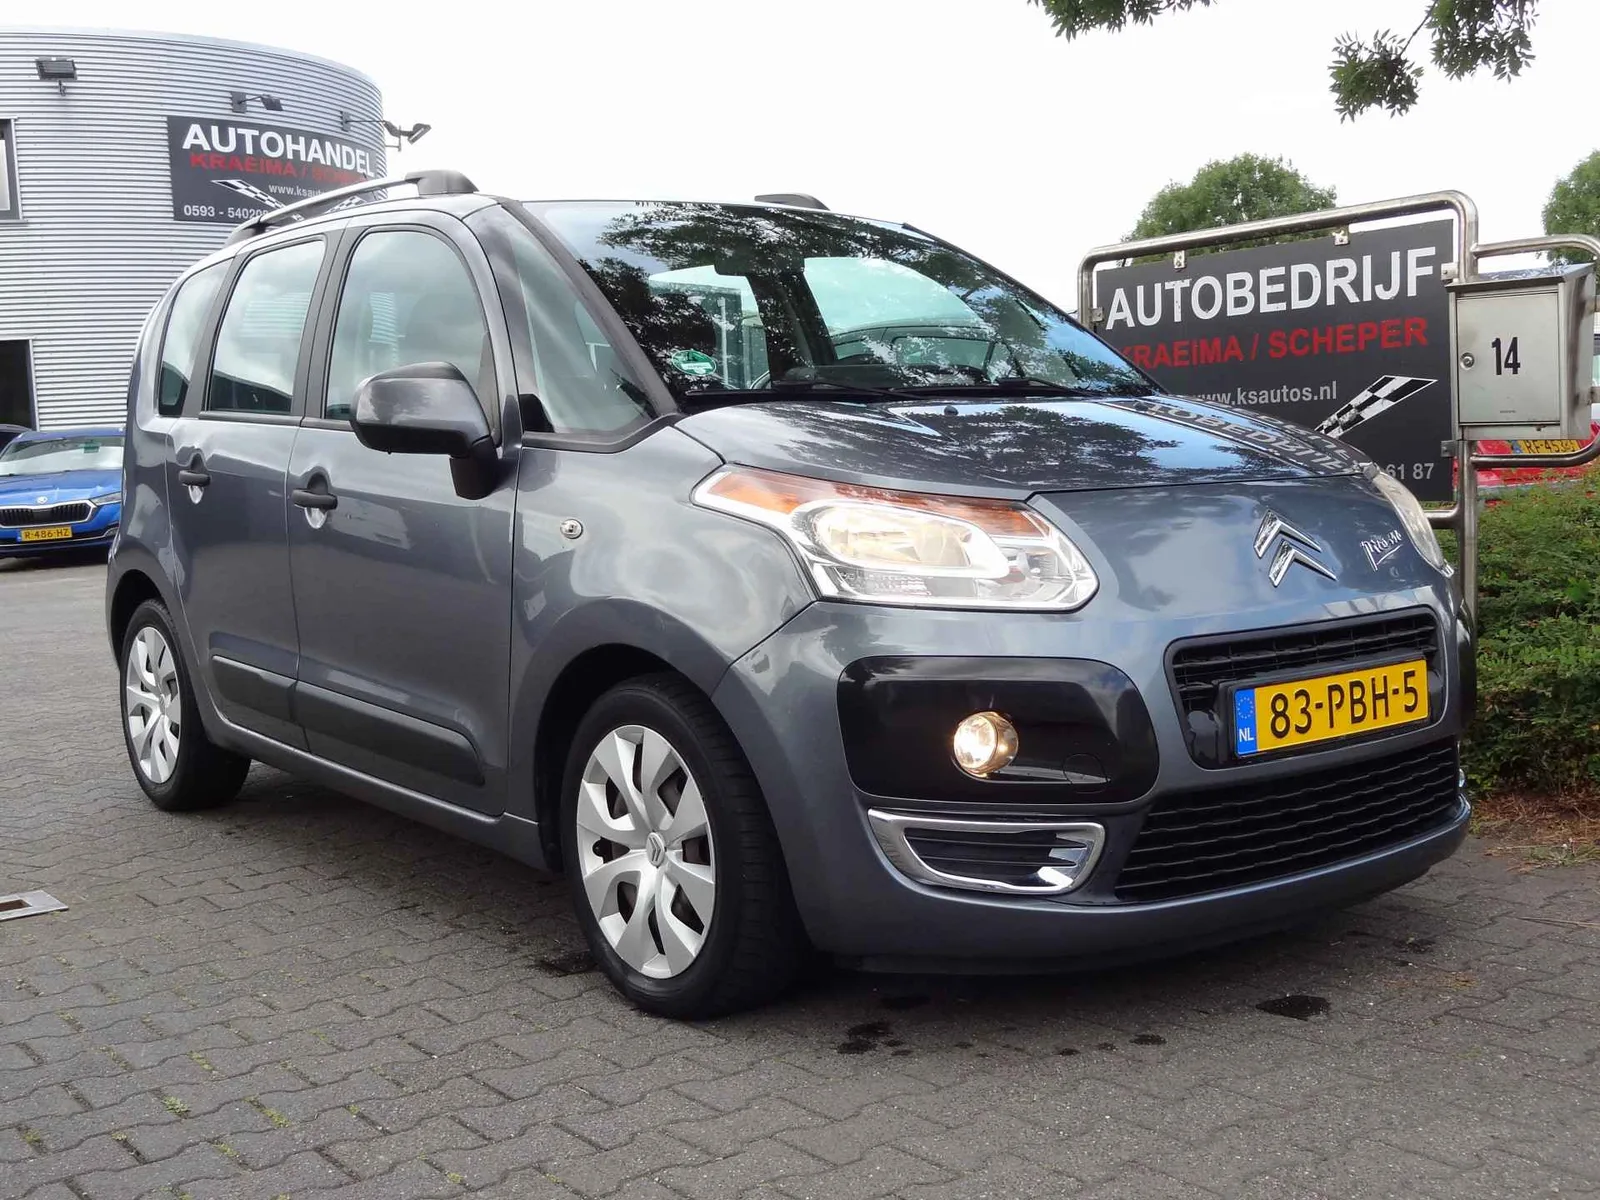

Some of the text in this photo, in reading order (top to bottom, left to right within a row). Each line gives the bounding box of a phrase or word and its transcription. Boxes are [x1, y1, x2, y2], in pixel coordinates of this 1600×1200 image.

[182, 123, 375, 177] AUTOHANDEL
[189, 152, 297, 178] KRAEIMA
[268, 183, 327, 197] www.ksaut
[183, 204, 216, 217] 0593
[1105, 246, 1436, 331] AUTOBEDRIJF
[1121, 337, 1244, 370] RAEIMA
[1268, 316, 1428, 359] SCHEPER
[1491, 336, 1521, 375] 14
[1413, 462, 1434, 480] 87
[24, 528, 70, 540] R-486-HZ
[1270, 670, 1419, 739] 83-PBH-5
[1238, 728, 1255, 742] NL
